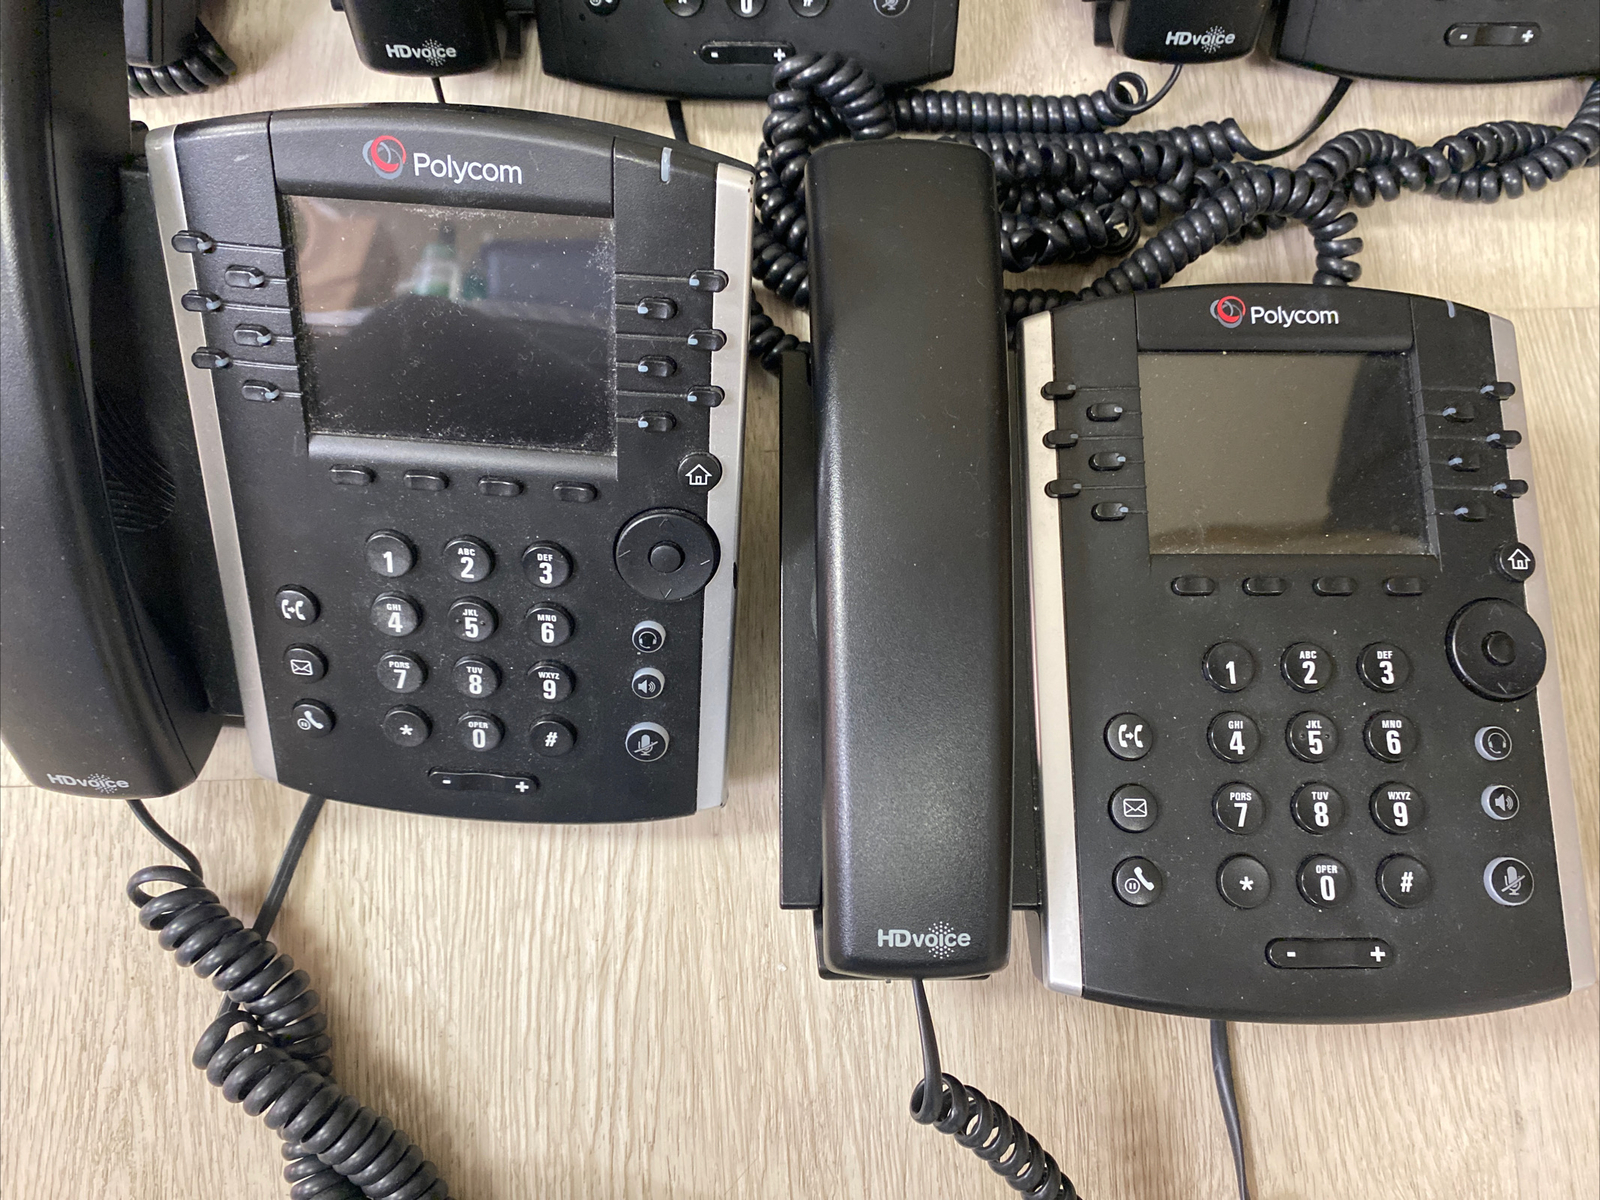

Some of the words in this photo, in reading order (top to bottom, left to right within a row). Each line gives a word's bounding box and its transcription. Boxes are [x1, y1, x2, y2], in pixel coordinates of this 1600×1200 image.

[1165, 30, 1236, 47] HDvoice
[385, 43, 457, 61] HDvoice
[413, 152, 523, 185] Polycom
[1250, 305, 1339, 328] Polycom
[457, 547, 476, 557] ABC
[536, 553, 553, 562] DEF
[382, 552, 394, 574] 1
[460, 557, 475, 579] 2
[539, 563, 553, 585] 3
[387, 612, 404, 633] 4
[462, 608, 479, 617] JKL
[536, 613, 557, 623] MNO
[464, 617, 479, 639] 5
[540, 623, 555, 644] 6
[1299, 650, 1317, 660] ABC
[1376, 650, 1393, 660] DEF
[392, 670, 407, 689] 7
[465, 666, 483, 675] TUV
[537, 671, 560, 680] WXYZ
[1225, 661, 1237, 685] 1
[1302, 661, 1318, 685] 2
[1379, 661, 1395, 685] 3
[468, 675, 483, 695] 8
[542, 680, 557, 700] 9
[467, 721, 489, 729] OPER
[1228, 720, 1244, 730] GHI
[1305, 719, 1323, 729] JKL
[1381, 719, 1403, 729] MNO
[472, 729, 486, 749] 0
[544, 731, 558, 747] #
[1229, 731, 1246, 755] 4
[1307, 731, 1324, 755] 5
[1385, 730, 1402, 755] 6
[46, 772, 130, 790] HDvoice
[1229, 791, 1252, 801] PQRS
[1311, 791, 1330, 801] TUV
[1387, 791, 1412, 801] WXYZ
[1233, 803, 1248, 828] 7
[1313, 802, 1330, 827] 8
[1392, 802, 1409, 827] 9
[1315, 864, 1338, 874] OPER
[1319, 876, 1336, 901] 0
[1400, 871, 1414, 893] #
[877, 928, 971, 948] HDvoice
